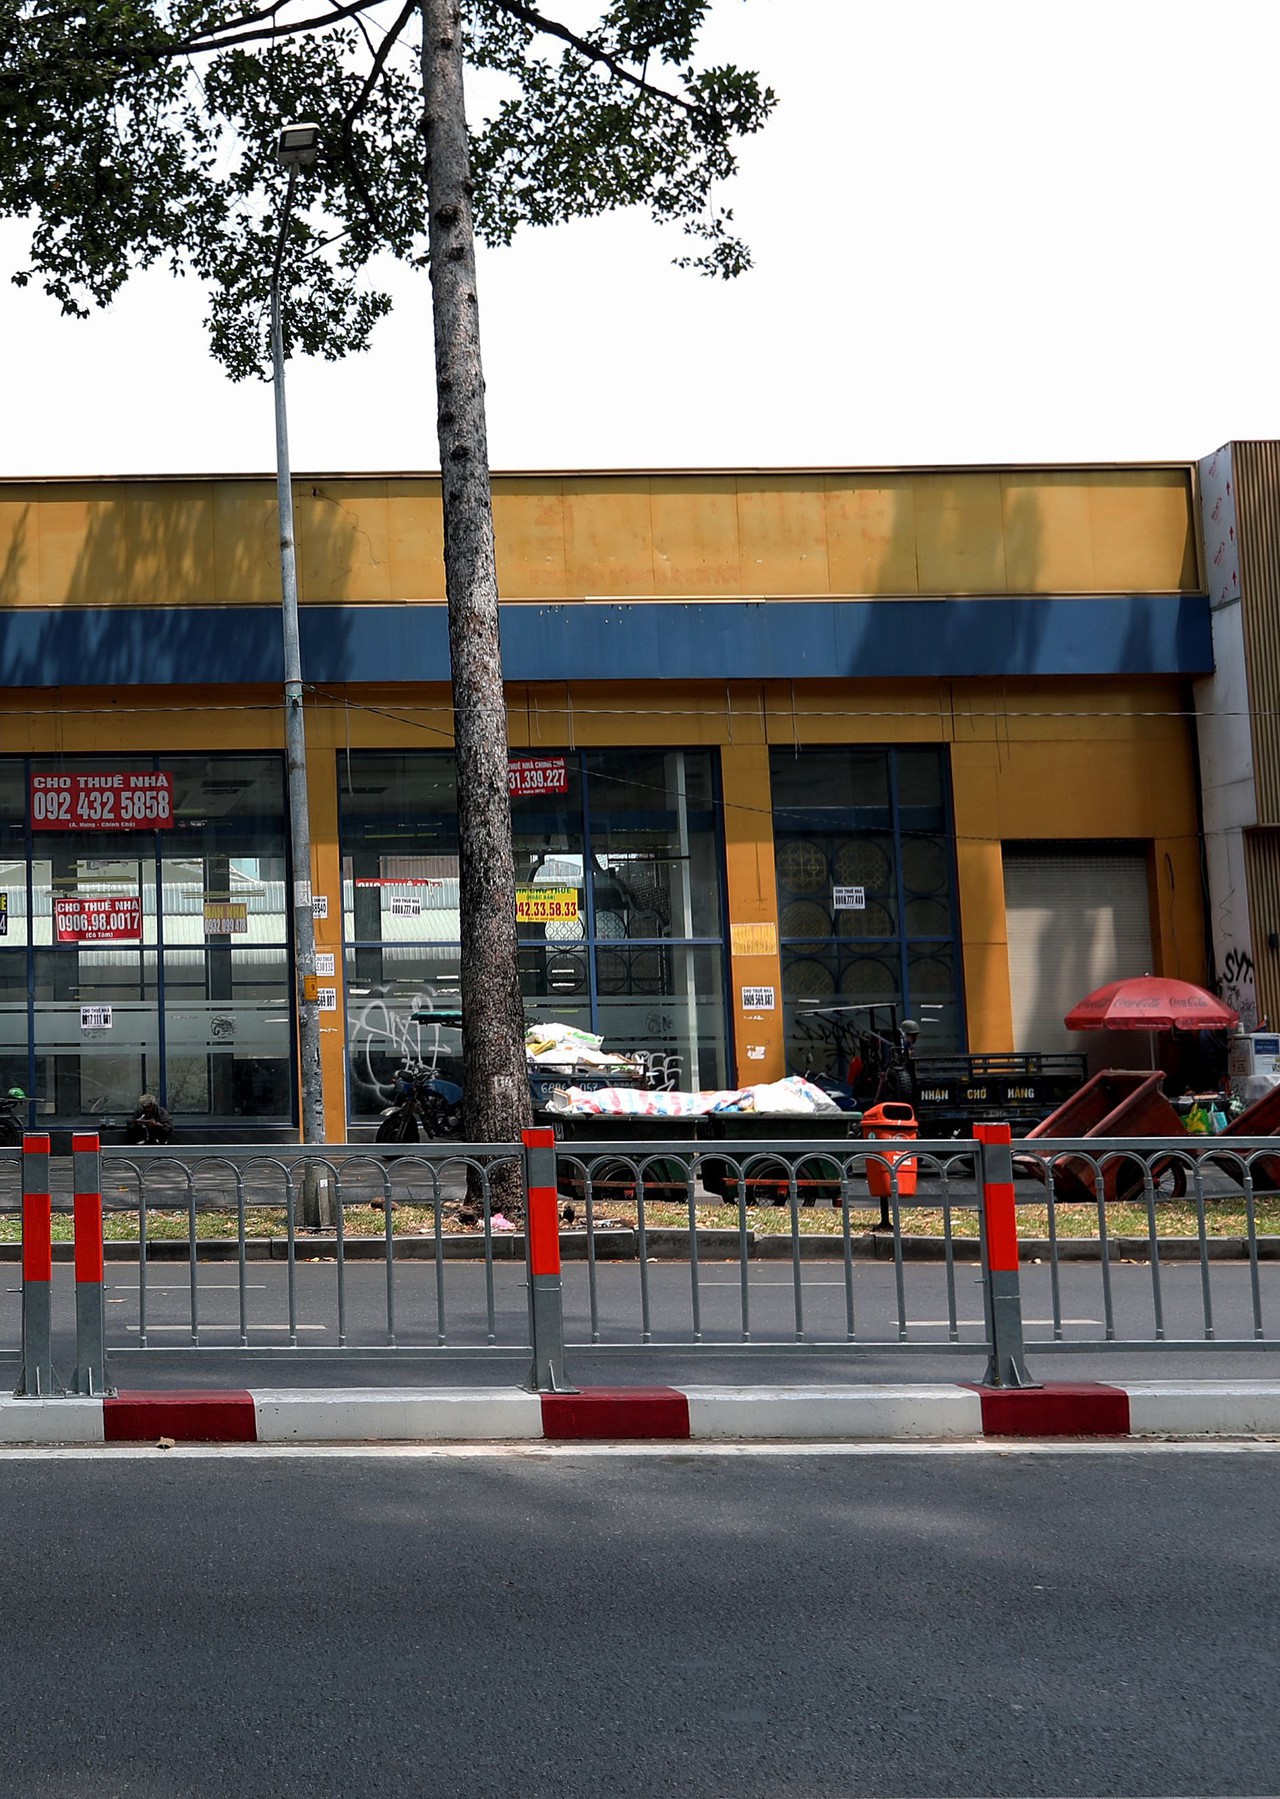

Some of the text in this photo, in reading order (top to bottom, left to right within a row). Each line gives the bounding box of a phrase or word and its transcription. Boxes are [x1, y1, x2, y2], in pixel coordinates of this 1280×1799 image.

[33, 773, 169, 788] CHO THUÊ NHÀ
[33, 790, 170, 820] 092 432 5858
[58, 900, 139, 912] CHO THUÊ NHÀ
[58, 912, 140, 931] 0906.98.0017
